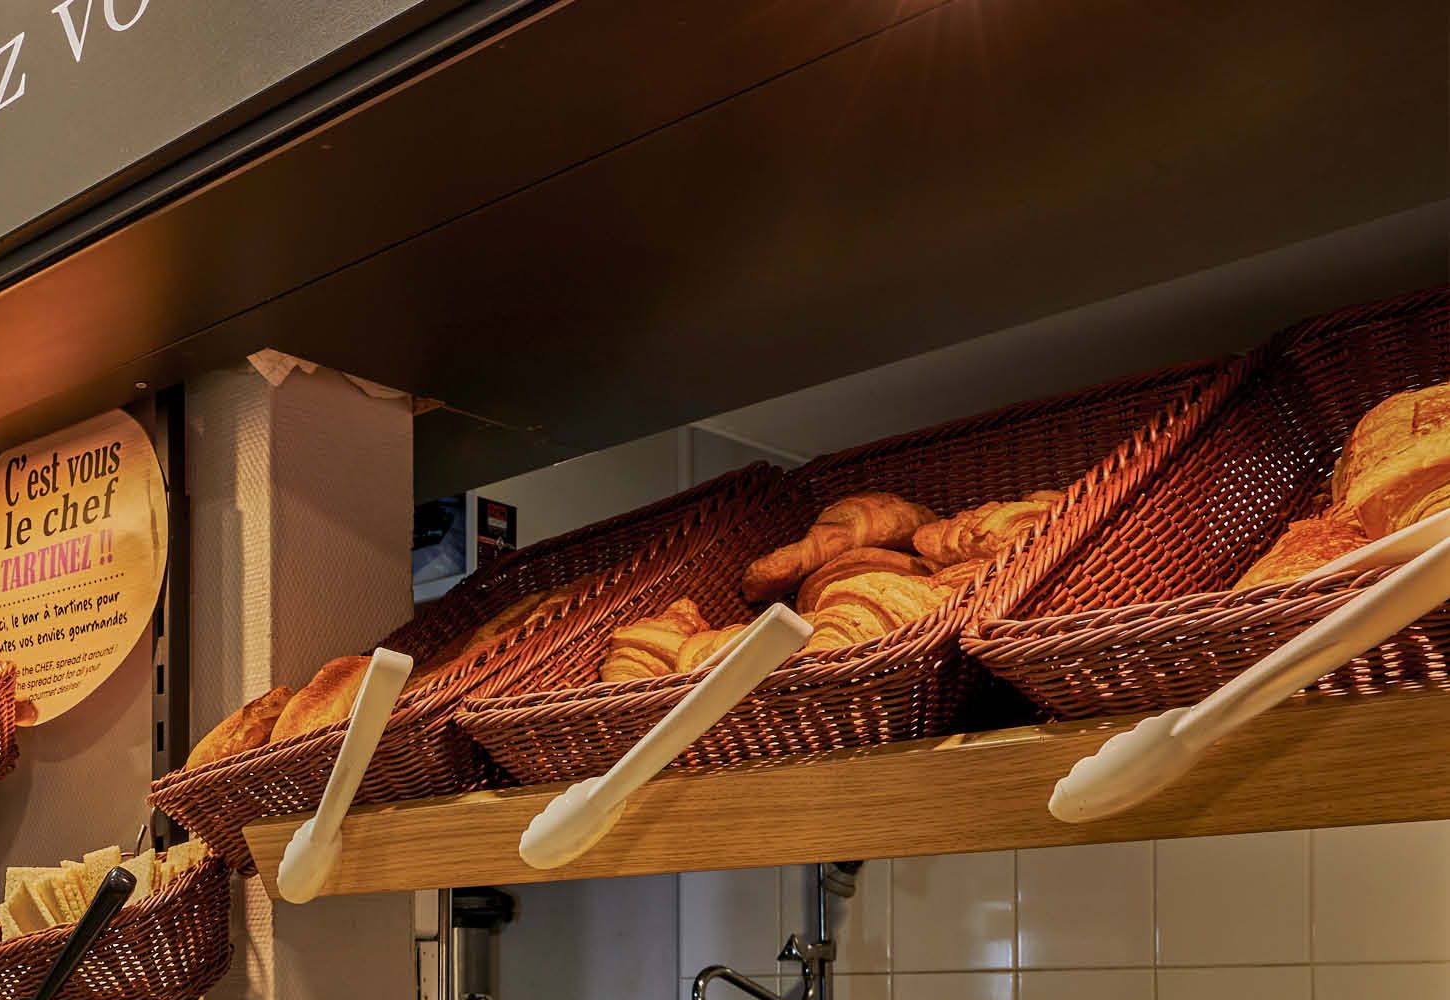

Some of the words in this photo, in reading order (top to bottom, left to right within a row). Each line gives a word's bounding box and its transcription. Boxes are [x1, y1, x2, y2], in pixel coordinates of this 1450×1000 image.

[51, 0, 154, 63] vo
[67, 441, 122, 487] vous
[4, 511, 32, 549] le
[43, 476, 118, 536] chef
[0, 533, 92, 593] TARTINEZ
[11, 615, 19, 628] le
[22, 612, 39, 625] bar
[43, 604, 50, 620] à
[53, 597, 93, 617] tartines
[96, 591, 120, 613] pour
[19, 635, 34, 648] vos
[37, 627, 66, 645] envies
[69, 611, 128, 642] gourmandes
[17, 682, 26, 690] he
[27, 676, 52, 691] spread
[53, 673, 65, 683] bar
[65, 670, 75, 680] for
[76, 667, 85, 677] all
[22, 665, 34, 676] the
[56, 654, 81, 670] spread
[82, 652, 88, 662] it
[88, 646, 114, 660] around
